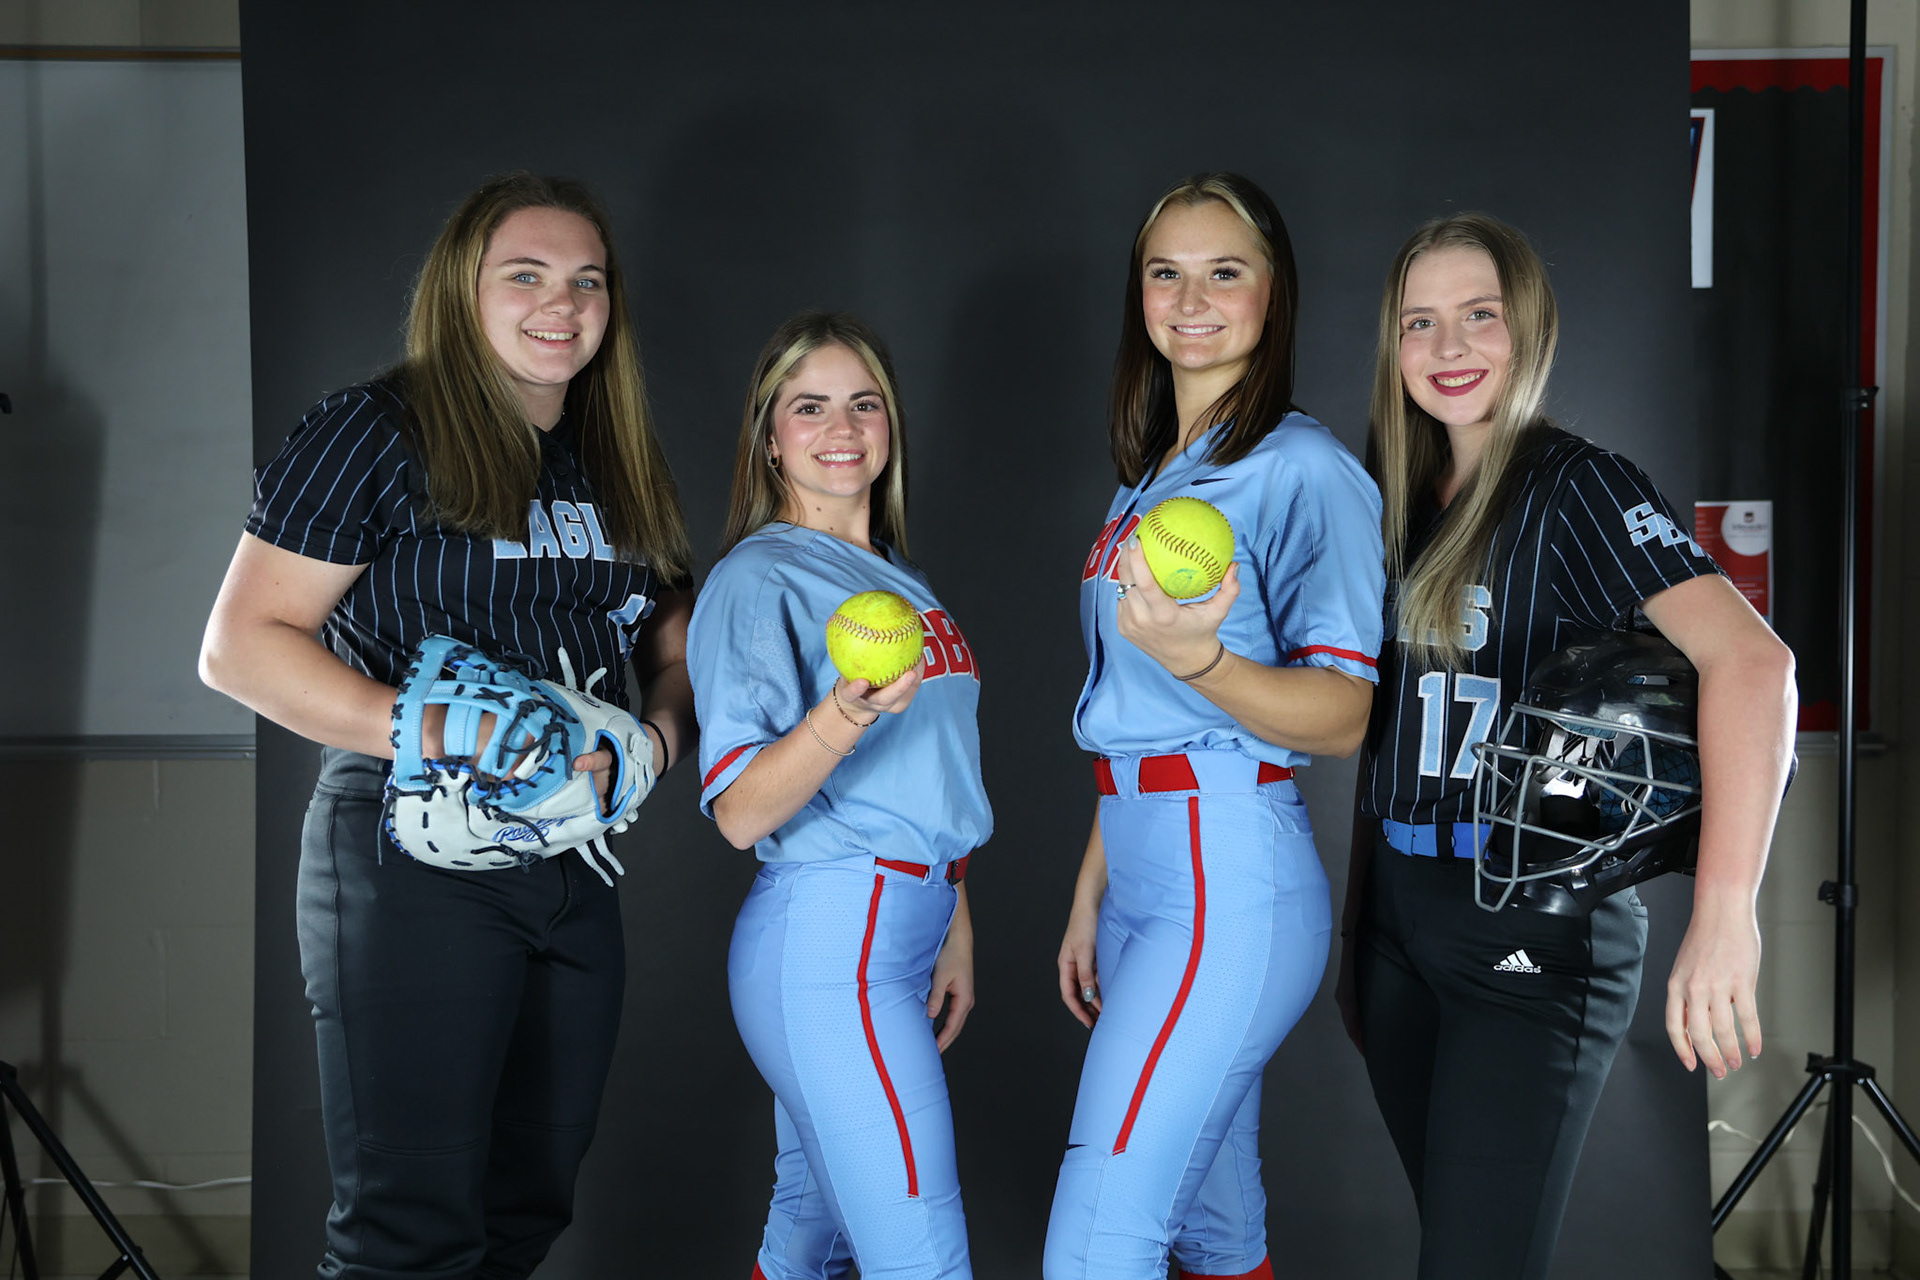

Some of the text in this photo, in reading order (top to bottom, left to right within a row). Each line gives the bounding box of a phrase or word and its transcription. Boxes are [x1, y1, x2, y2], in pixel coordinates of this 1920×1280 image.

[493, 499, 646, 566] AGL
[1417, 671, 1502, 780] 17
[1493, 964, 1542, 974] adidas
